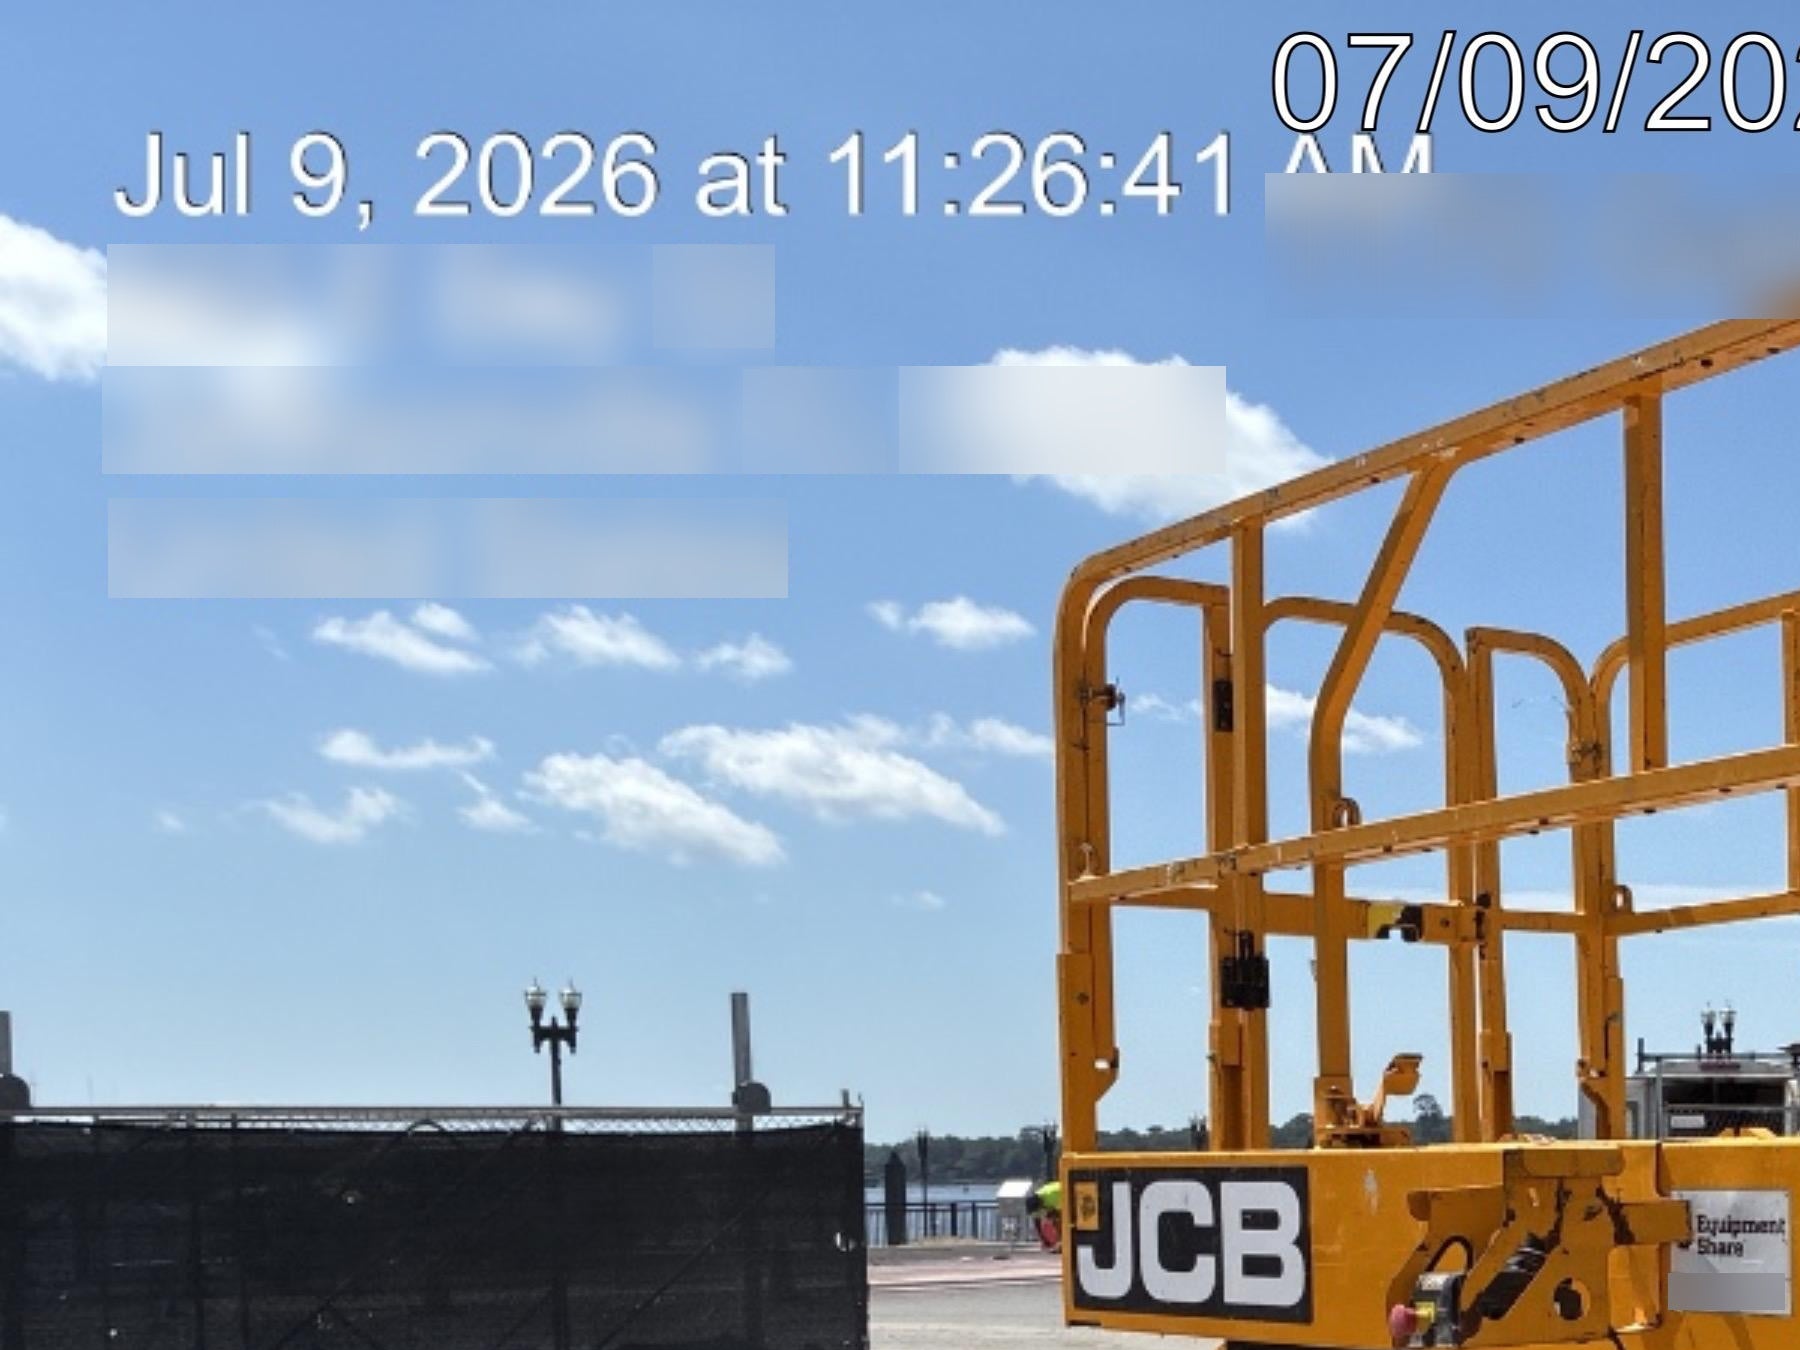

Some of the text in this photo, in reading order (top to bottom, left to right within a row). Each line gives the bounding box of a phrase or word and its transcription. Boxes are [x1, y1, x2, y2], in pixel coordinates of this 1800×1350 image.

[1695, 1214, 1786, 1238] Equipment
[1076, 1179, 1307, 1307] JCB
[1695, 1237, 1745, 1257] Share
